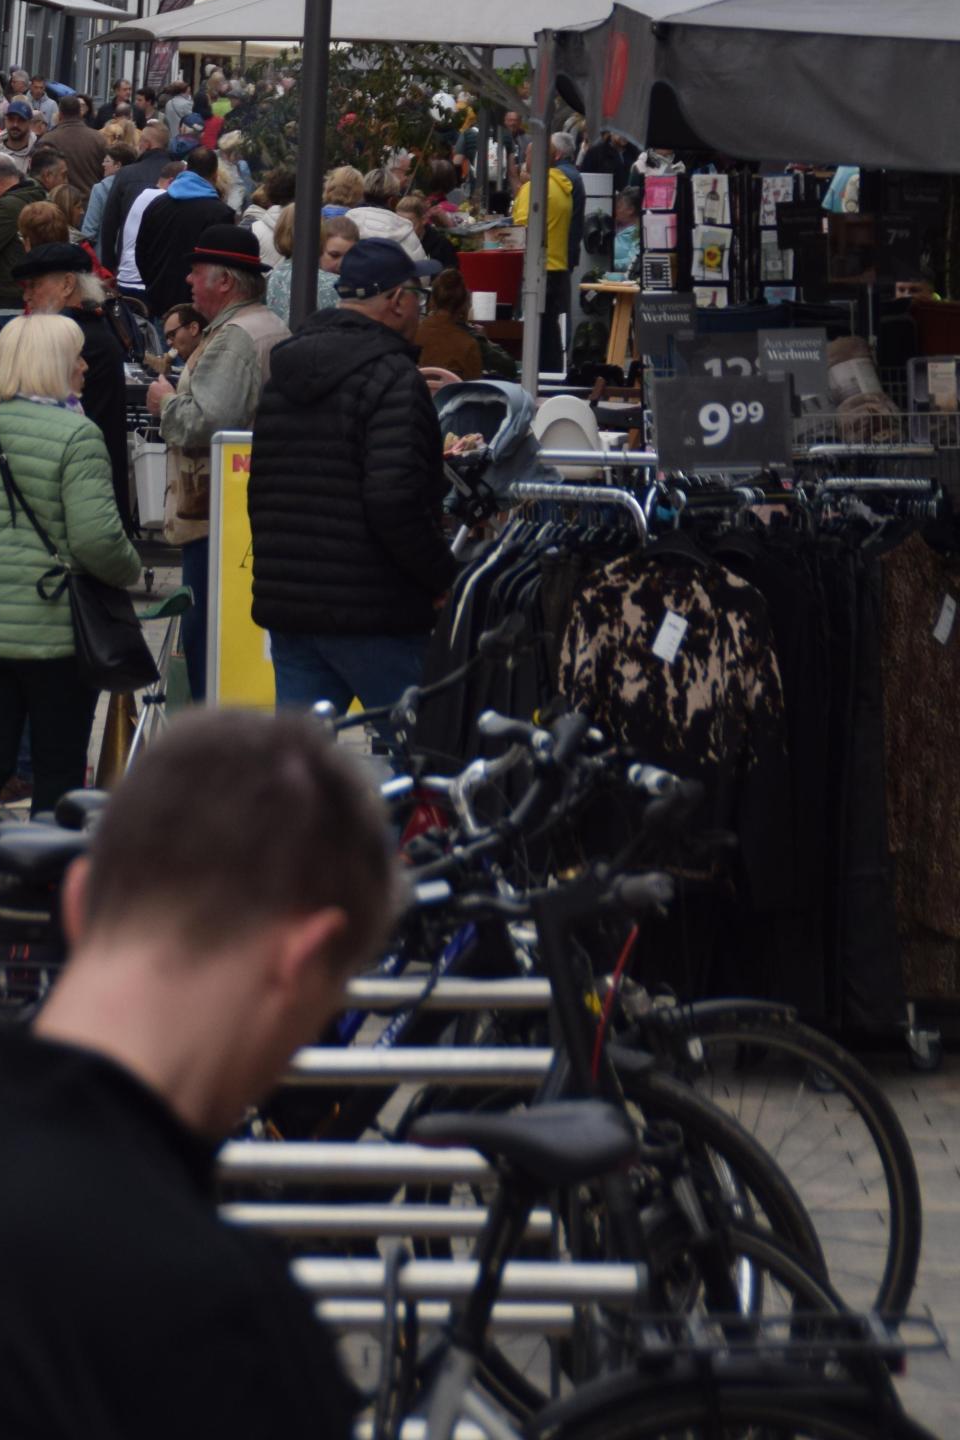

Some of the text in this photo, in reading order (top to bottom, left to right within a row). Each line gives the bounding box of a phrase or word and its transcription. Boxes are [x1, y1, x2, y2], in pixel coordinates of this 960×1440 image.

[642, 311, 690, 323] Werbung
[763, 337, 822, 348] Aus unserer
[767, 348, 820, 361] Werbung
